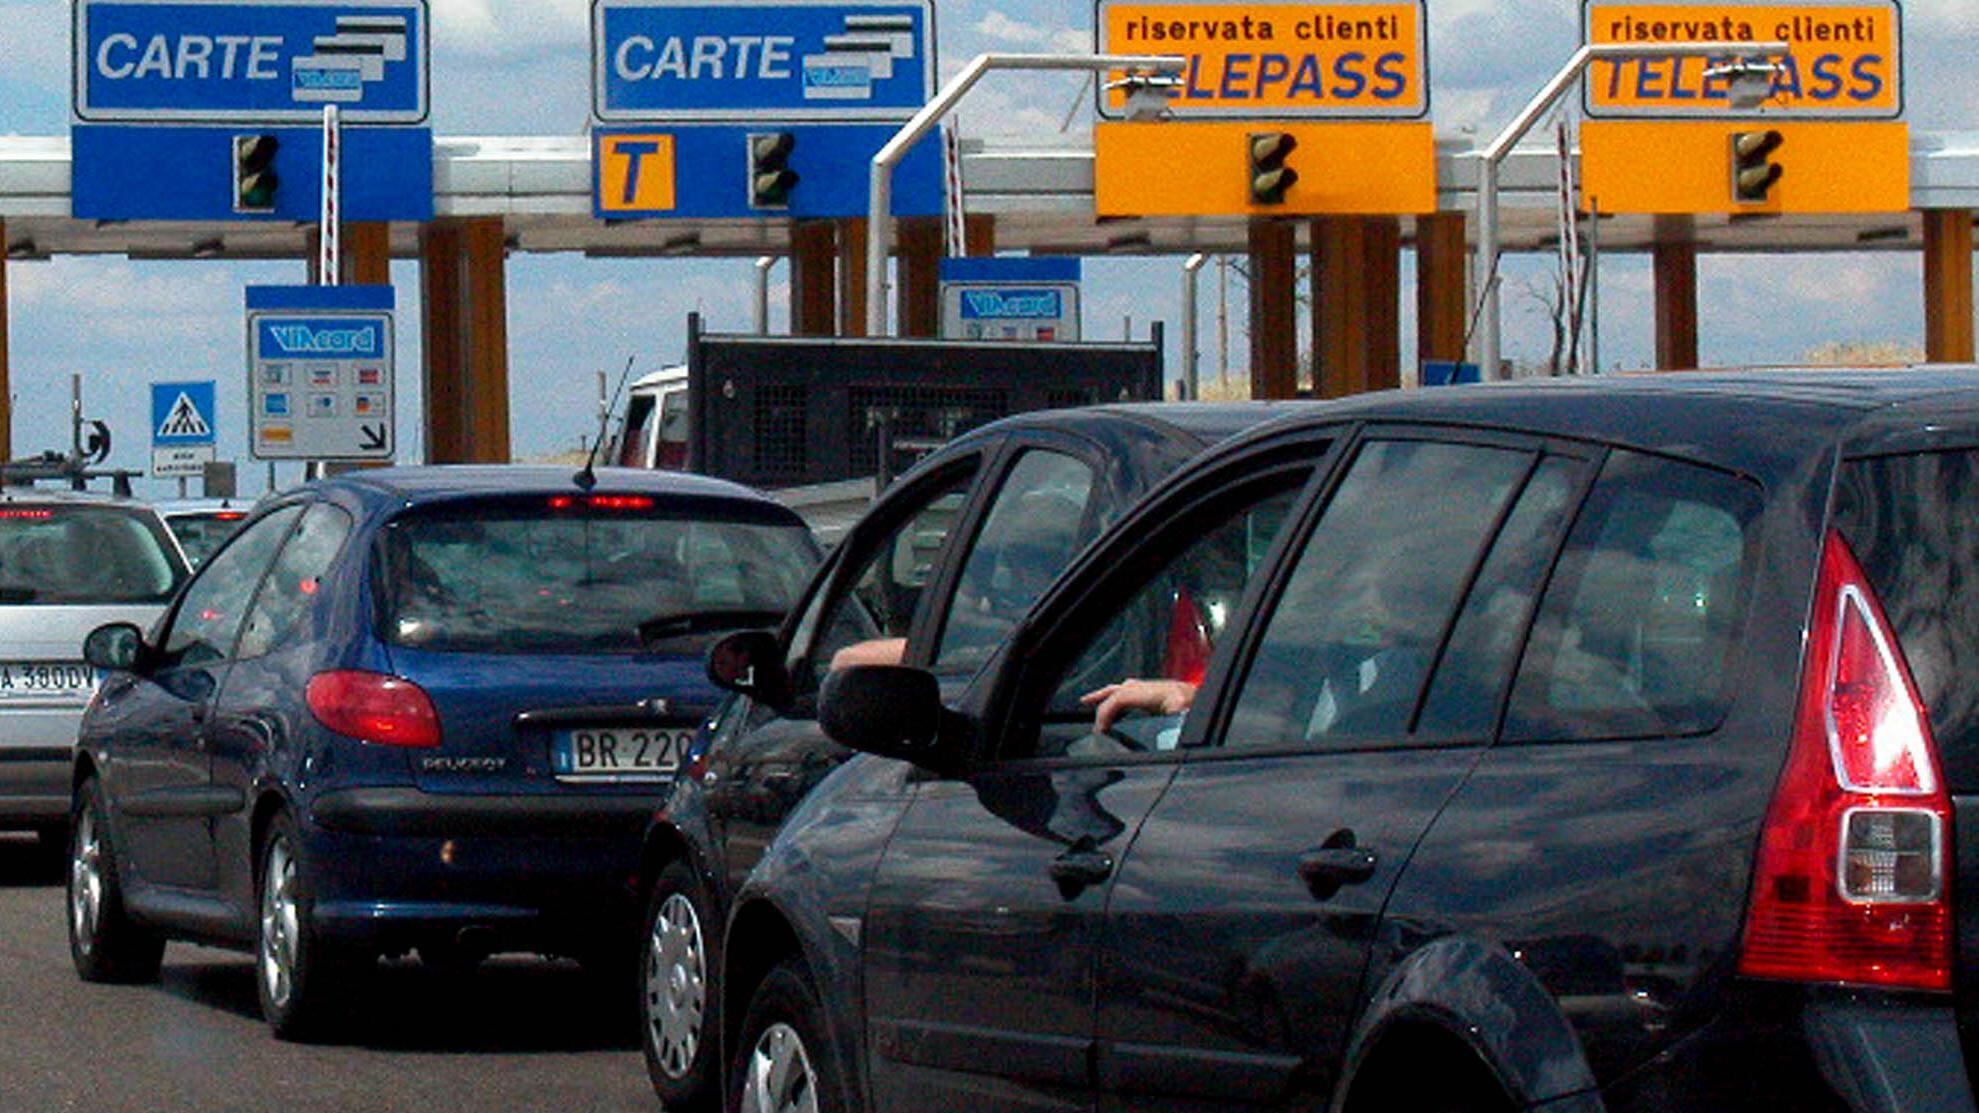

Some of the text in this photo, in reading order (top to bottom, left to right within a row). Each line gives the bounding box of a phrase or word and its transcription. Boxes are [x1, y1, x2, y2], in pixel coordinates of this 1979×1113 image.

[1126, 15, 1398, 40] riservata clienti
[1610, 16, 1874, 41] riservata clienti
[96, 33, 284, 80] CARTE
[614, 35, 795, 81] CARTE
[1124, 51, 1406, 99] LEPASS
[1606, 52, 1883, 99] TELEASS
[612, 141, 659, 205] T
[577, 731, 619, 768] BR
